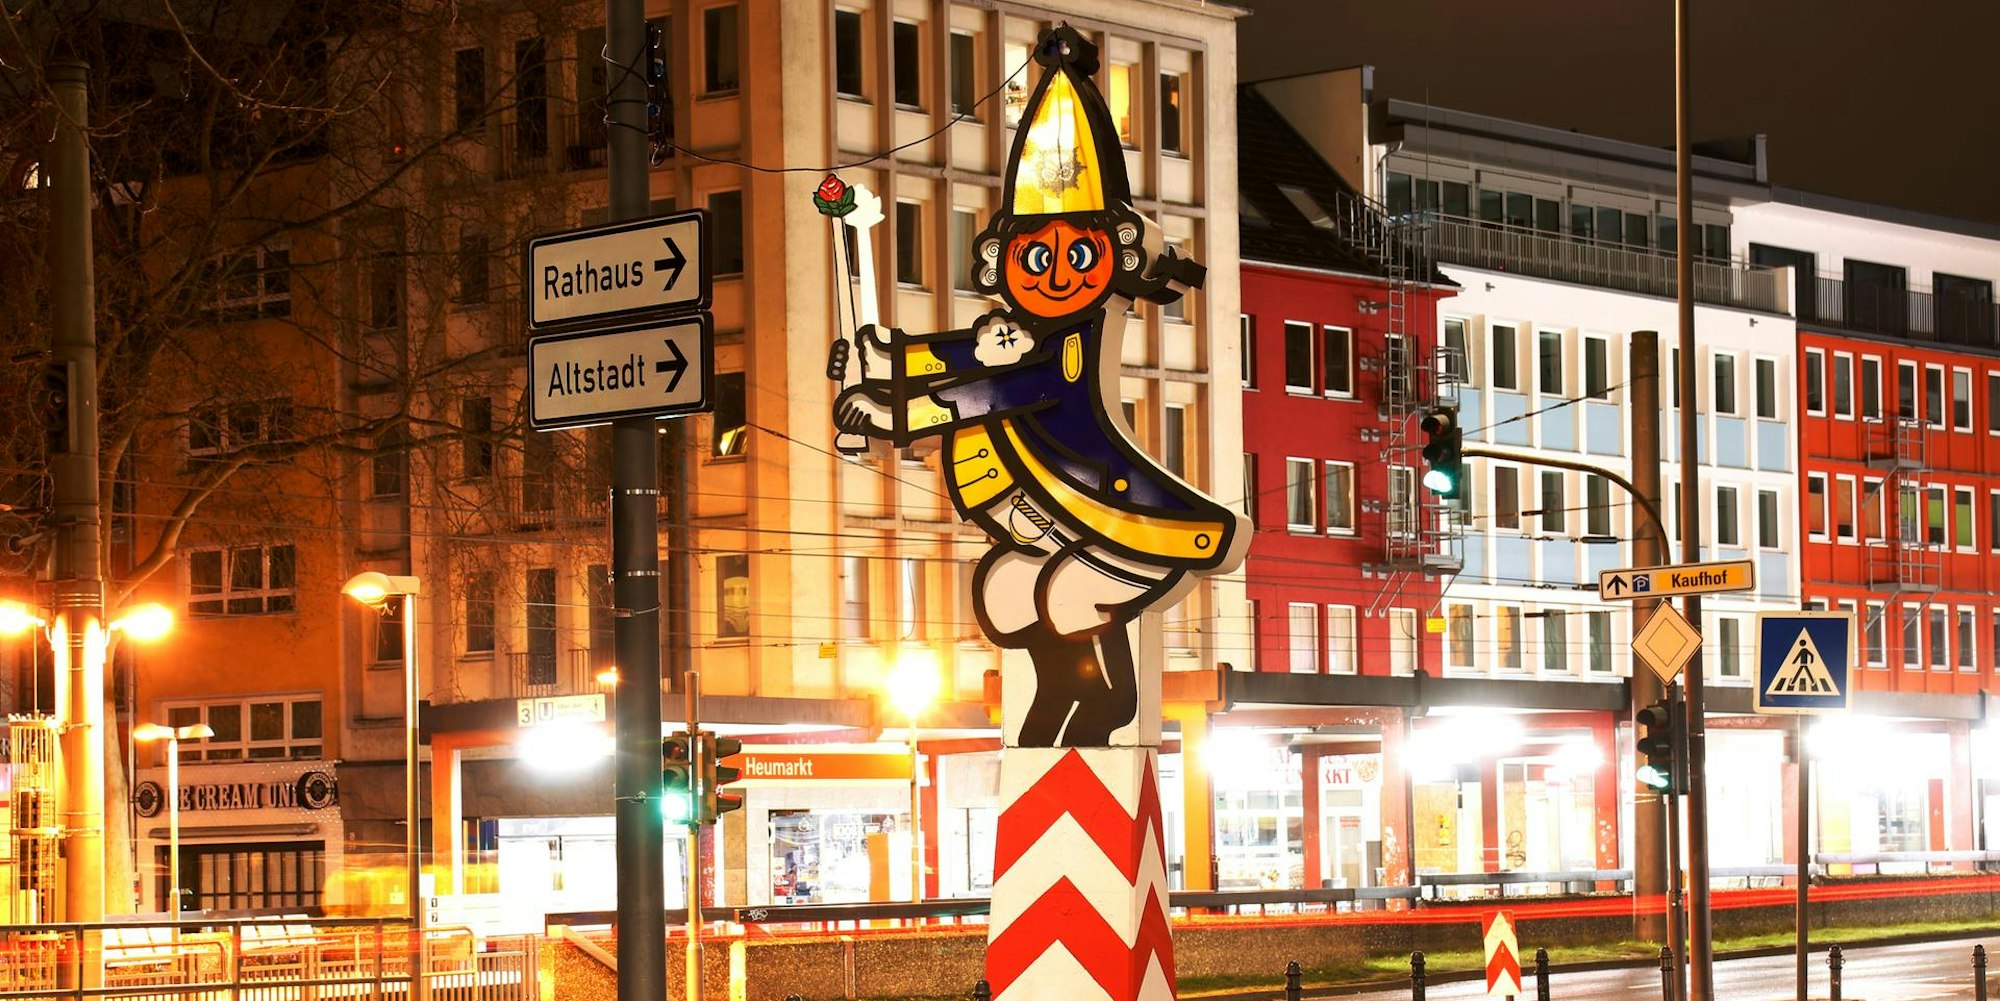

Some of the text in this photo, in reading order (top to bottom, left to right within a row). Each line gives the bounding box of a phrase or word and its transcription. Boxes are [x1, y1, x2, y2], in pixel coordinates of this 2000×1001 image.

[543, 259, 644, 300] Rathaus
[547, 353, 646, 398] Altstadt
[1671, 569, 1728, 588] Kaufhof
[521, 707, 531, 724] 3
[745, 756, 813, 776] Heumarkt
[163, 785, 191, 811] IE
[193, 783, 260, 811] CREAM
